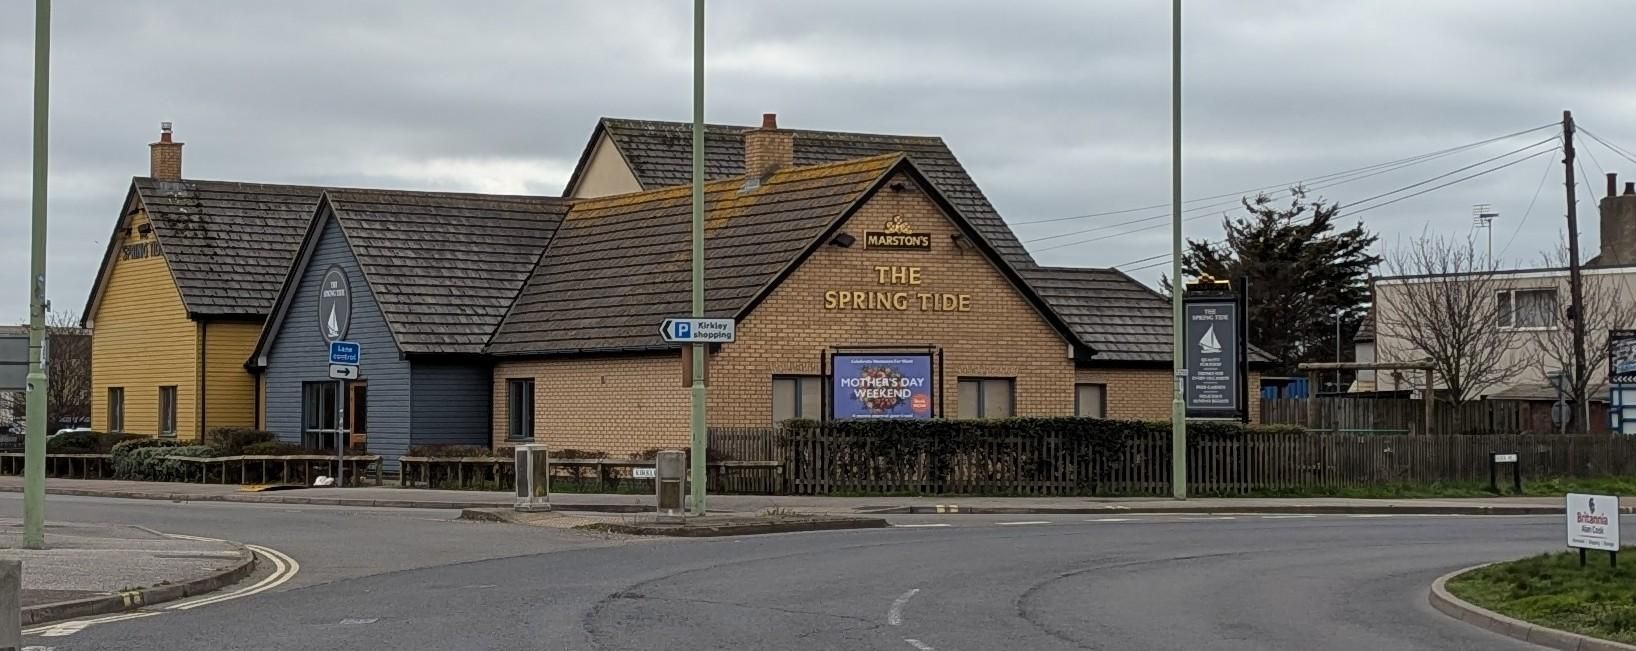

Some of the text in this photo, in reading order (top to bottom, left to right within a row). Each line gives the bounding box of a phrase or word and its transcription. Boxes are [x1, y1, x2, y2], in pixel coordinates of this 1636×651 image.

[868, 235, 929, 247] MARSTON'S
[875, 265, 922, 285] THE
[824, 290, 972, 312] SPRING TIDE
[697, 321, 728, 331] Kirkley
[694, 331, 732, 340] shopping
[337, 345, 353, 353] Lane
[333, 353, 357, 361] control
[840, 377, 925, 388] MOTHER'S DAY
[853, 388, 912, 398] WEEKEND
[1576, 510, 1609, 526] Britannia
